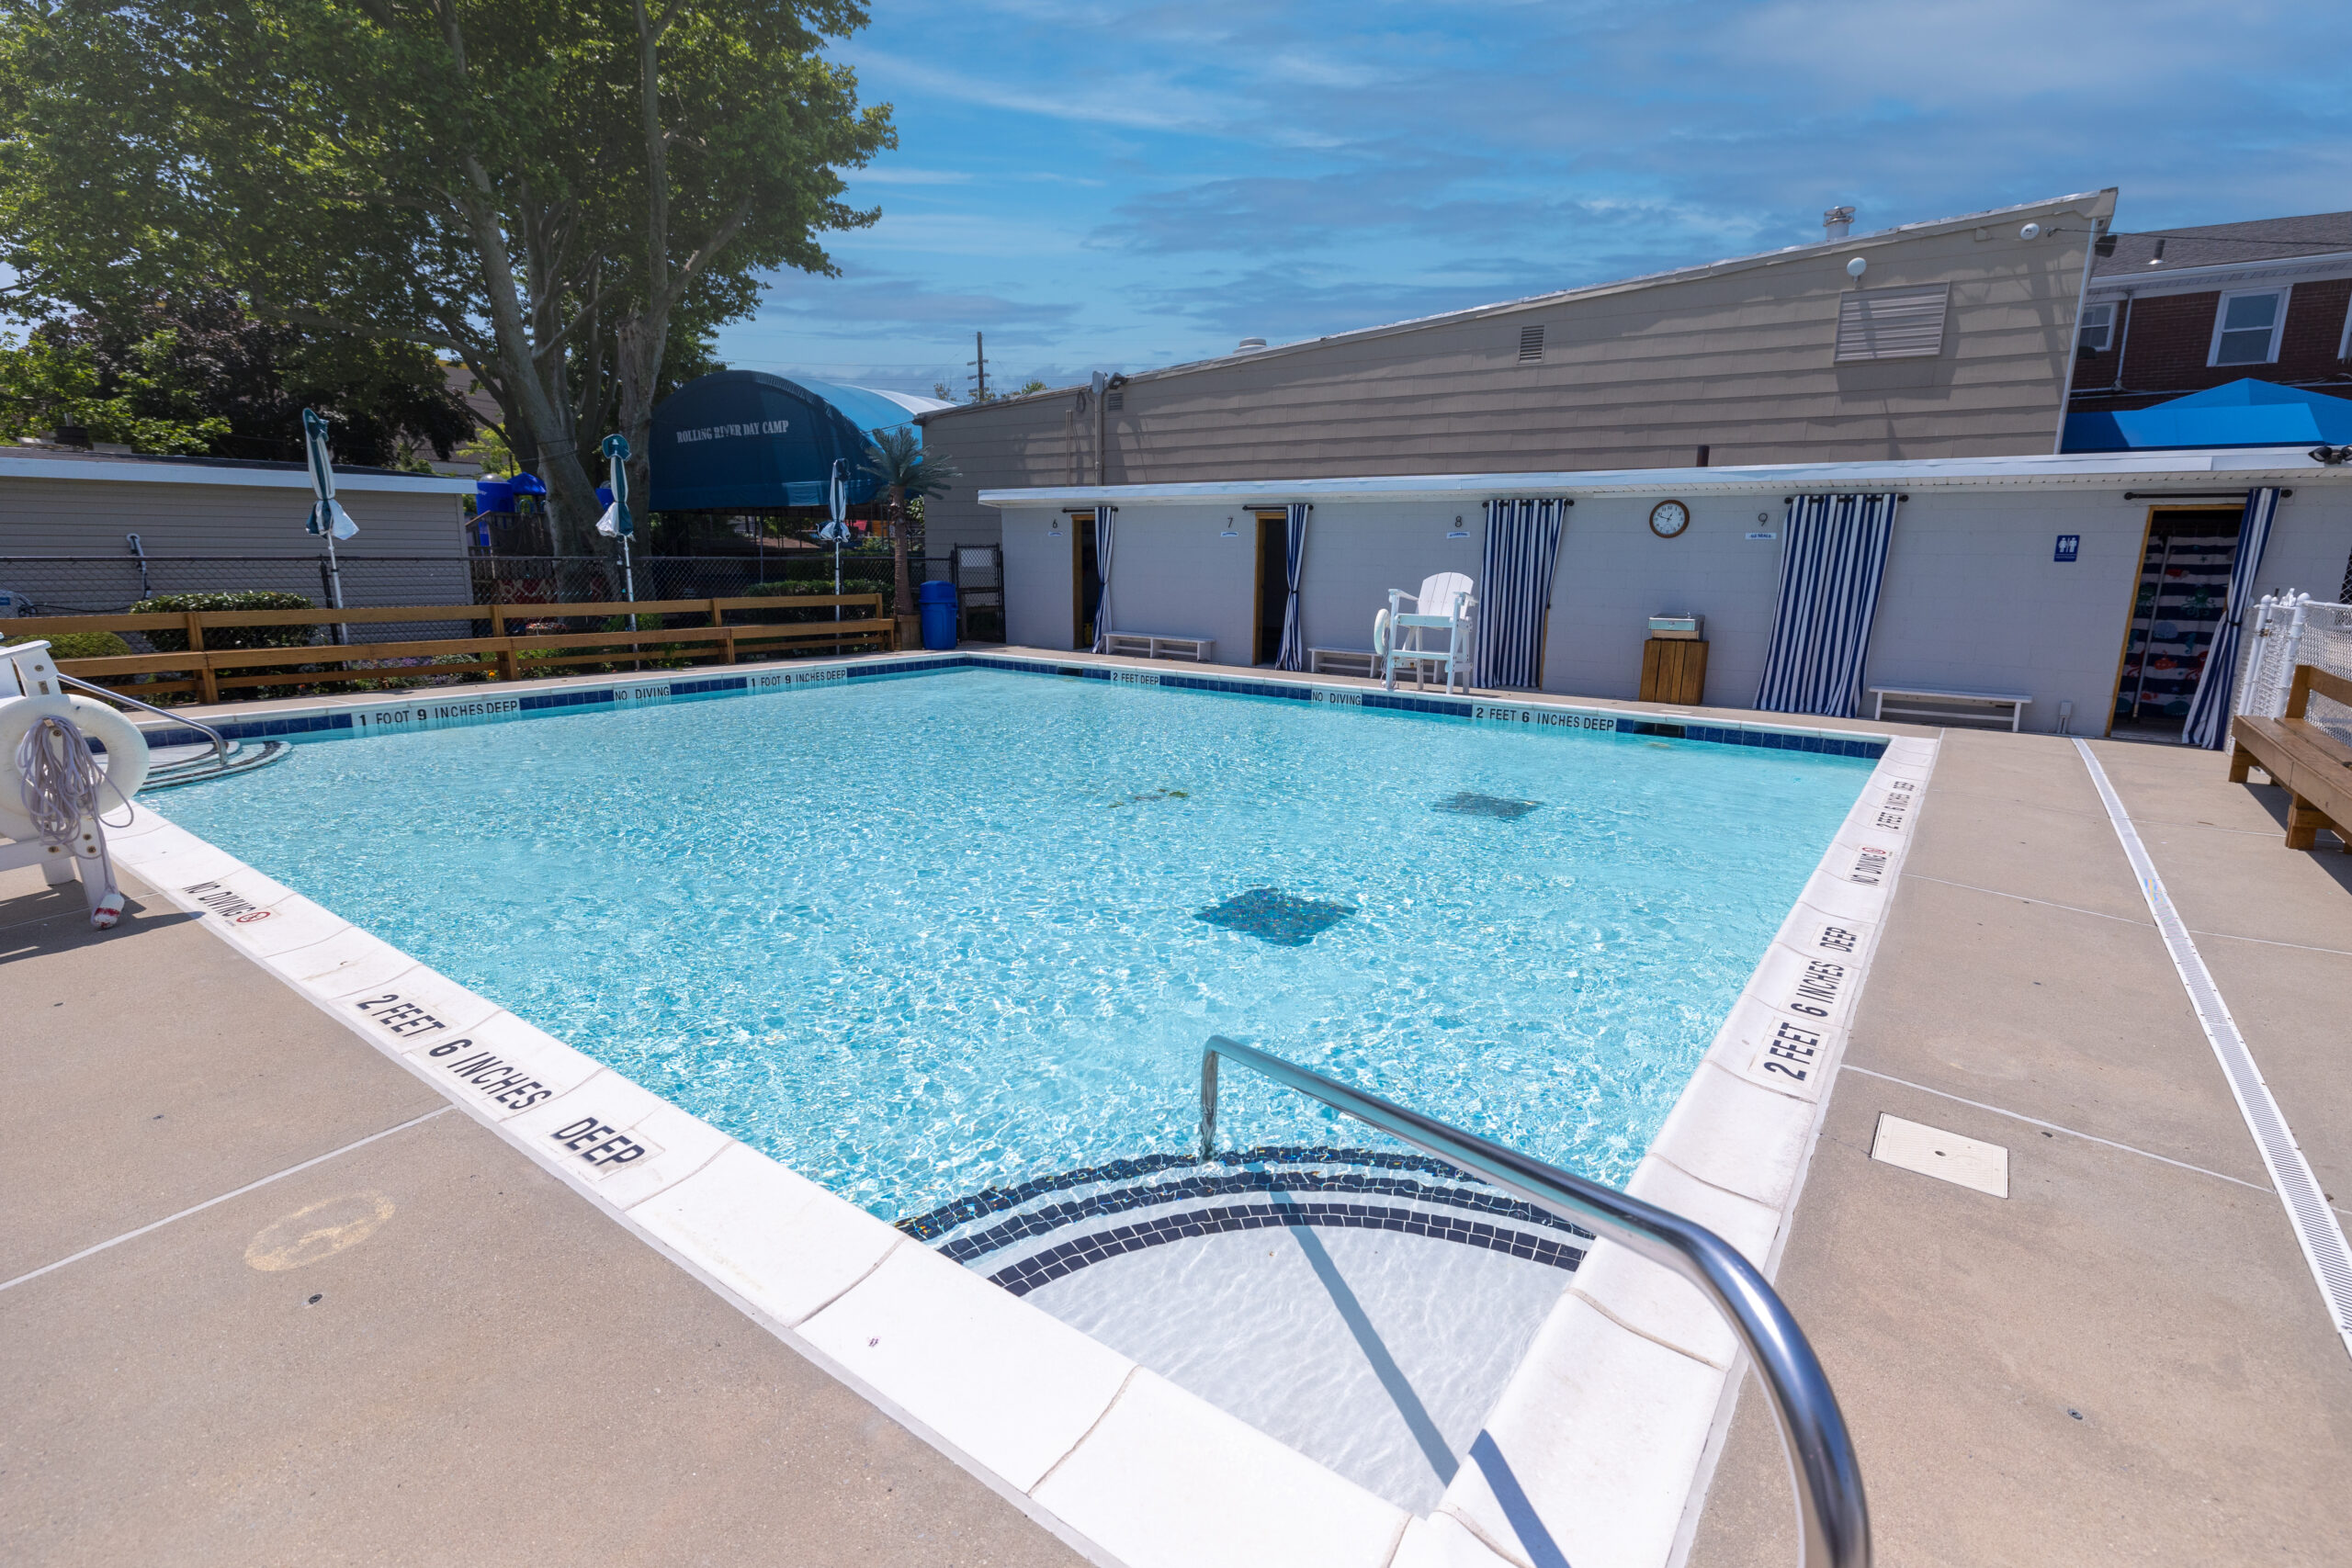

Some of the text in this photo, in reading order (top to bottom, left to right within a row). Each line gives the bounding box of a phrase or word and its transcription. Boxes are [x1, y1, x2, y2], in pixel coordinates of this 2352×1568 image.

[676, 421, 788, 443] ROLLING RIVER DAY CAMP
[1053, 519, 1057, 528] 6
[1227, 517, 1233, 528] 7
[1455, 515, 1462, 527] 8
[1758, 513, 1768, 527] 9
[752, 670, 846, 687] 1 FOOT 9 INCHES DEEP
[1113, 672, 1159, 684] 2 FEET DEEP
[615, 686, 670, 701] NO DIVING
[1313, 692, 1361, 705] NO DIVING
[358, 700, 518, 726] 1 FOOT 9 INCHES DEEP
[1476, 707, 1614, 731] 2 FEET 6 INCHES DEEP
[182, 881, 256, 917] NO DIVING
[1764, 926, 1858, 1081] 2 FEET 6 INCHES DEEP
[356, 994, 645, 1167] 2 FEET 6 INCHES DEEP
